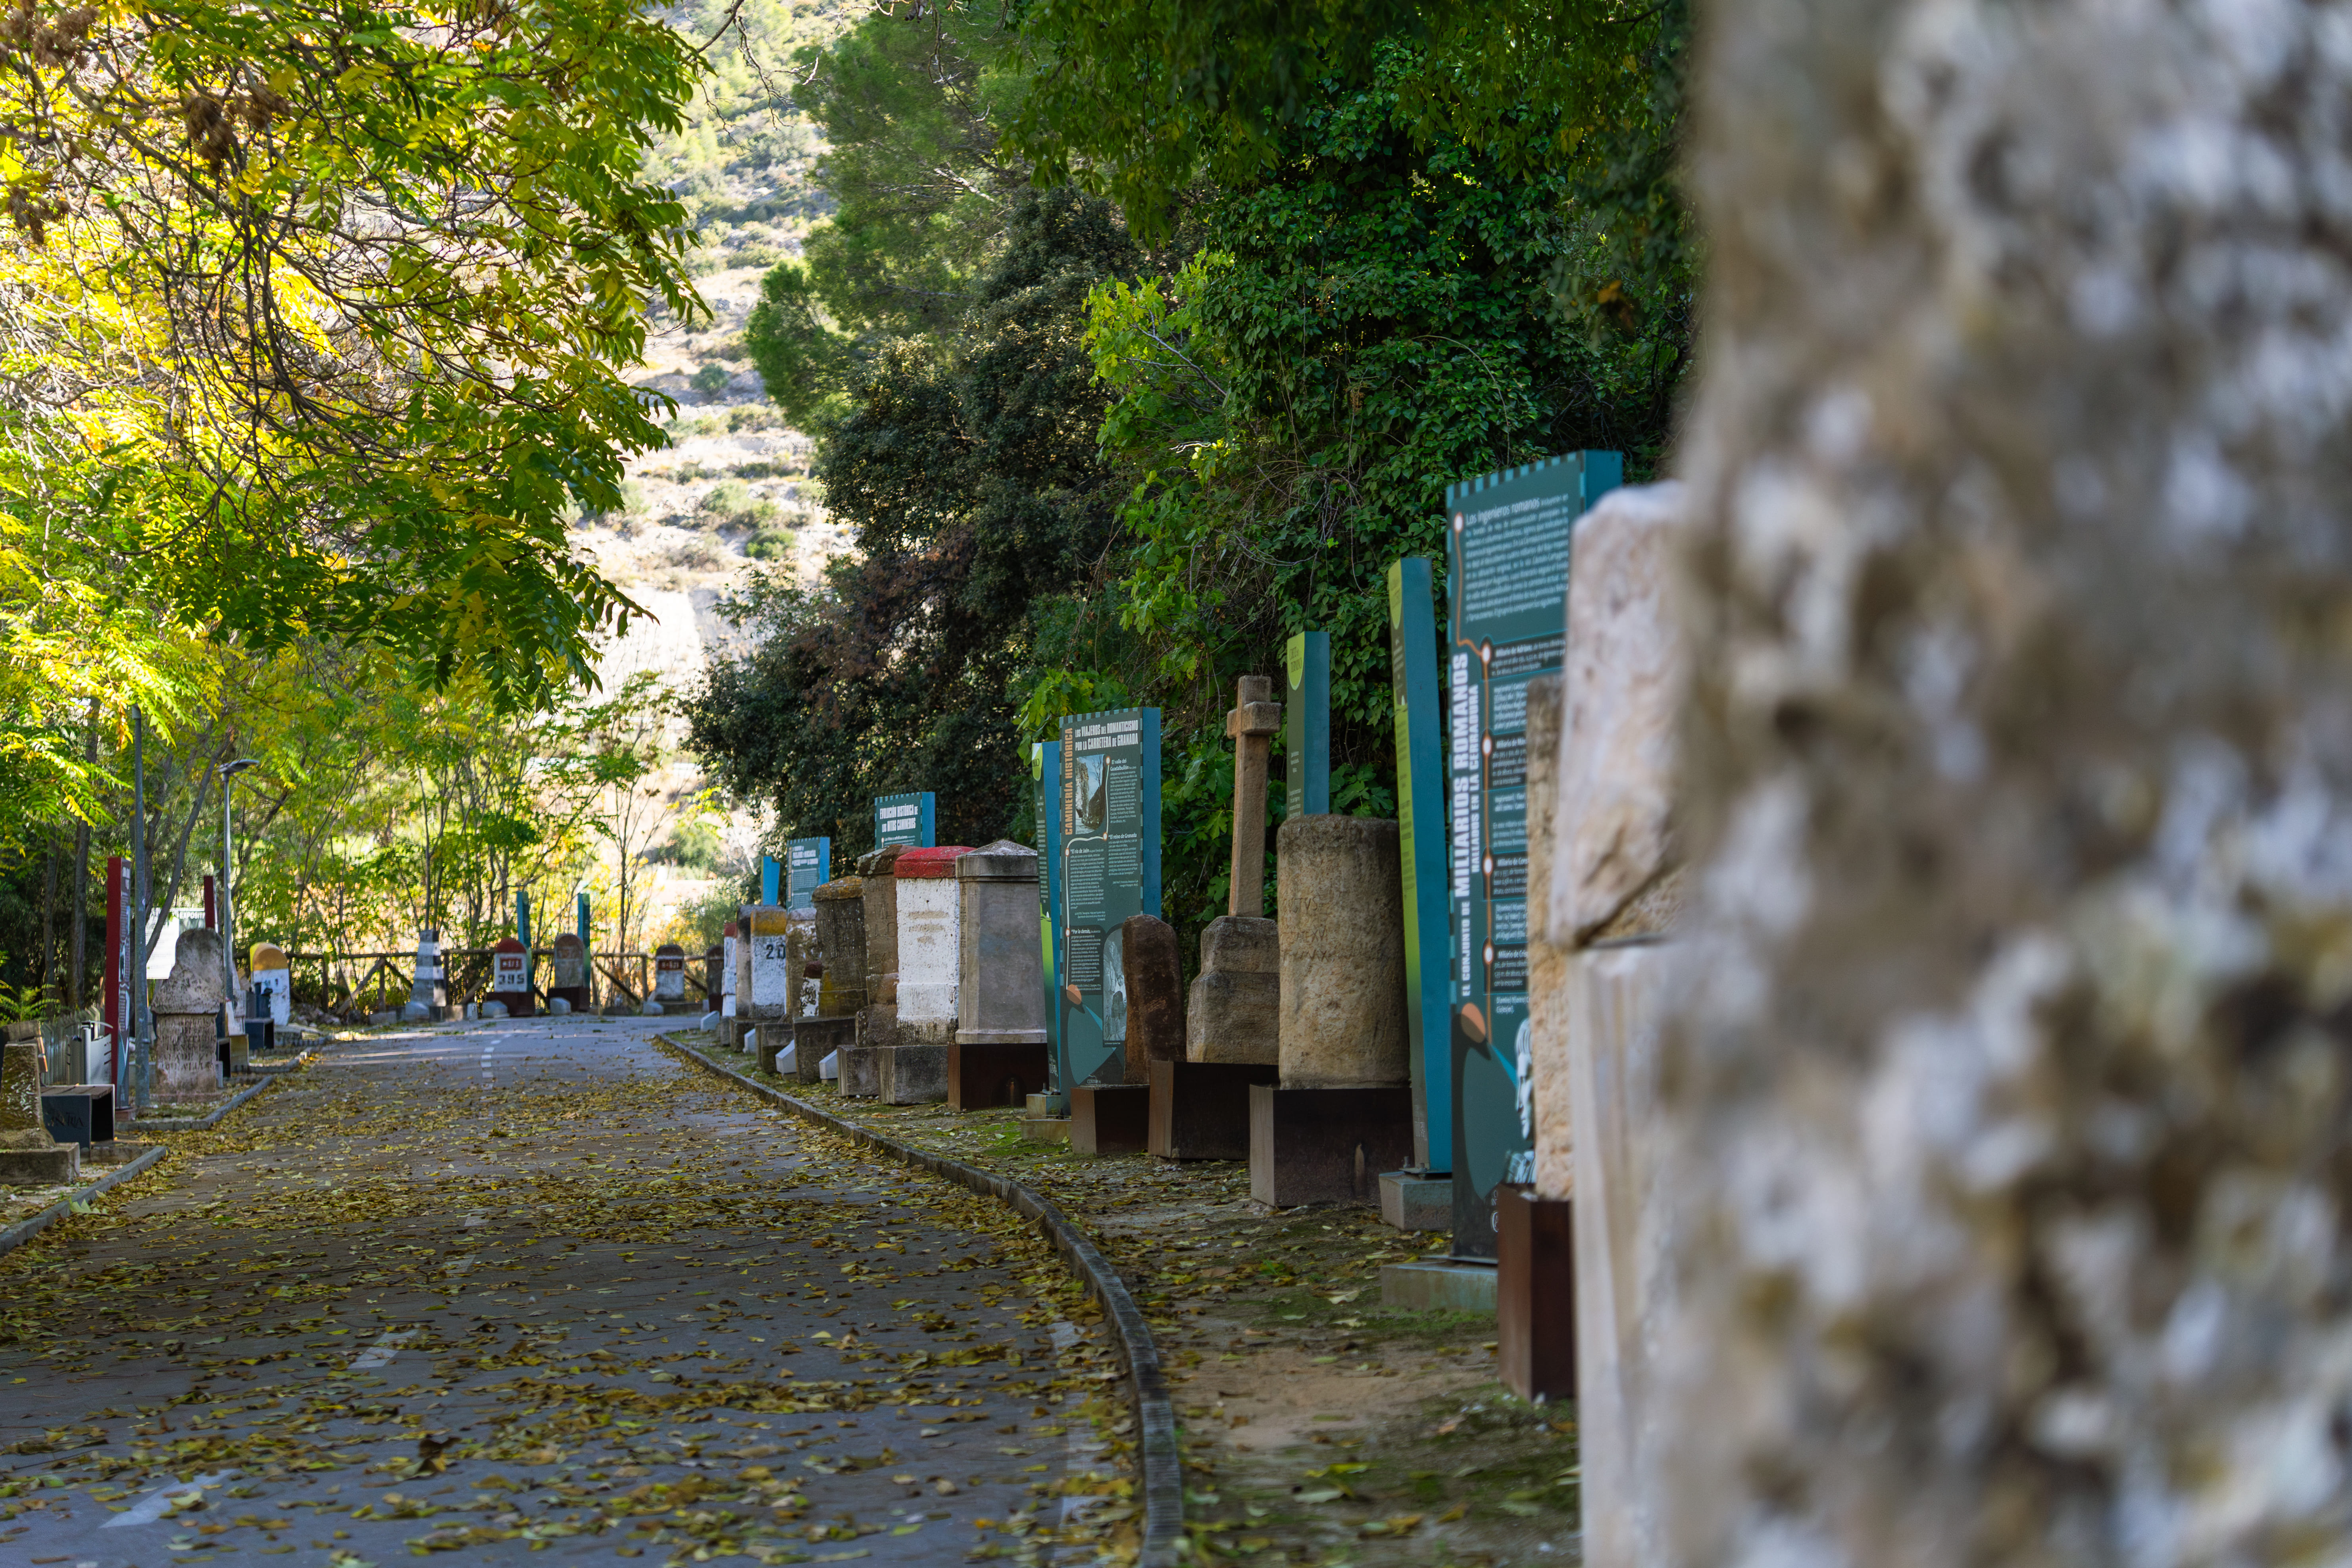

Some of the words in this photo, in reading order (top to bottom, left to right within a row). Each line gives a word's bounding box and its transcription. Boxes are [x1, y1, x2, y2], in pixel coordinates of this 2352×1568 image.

[1466, 513, 1477, 526] Los
[1511, 498, 1540, 513] romanos
[1452, 653, 1469, 770] ROMANOS
[1081, 724, 1100, 737] VIAJEROS
[1107, 720, 1138, 733] ROMANTICISMO
[1469, 685, 1479, 770] CERRADURA
[1083, 741, 1087, 750] LA
[1088, 736, 1111, 750] CARRETERA
[1112, 737, 1117, 747] DE
[1117, 733, 1138, 746] GRANADA
[1063, 727, 1073, 779] HISTÓRICA
[1470, 774, 1479, 791] LA
[880, 805, 897, 820] EVOLUCIÓN
[897, 804, 914, 818] HISTÓRICA
[914, 806, 918, 815] DE
[1064, 781, 1073, 835] CAMINERÍA
[1471, 795, 1479, 810] EN
[887, 820, 896, 832] HITOS
[897, 817, 916, 831] CAMINEROS
[1453, 776, 1469, 897] MILIARIOS
[1471, 813, 1479, 873] HALLADOS
[1461, 901, 1470, 915] DE
[1462, 919, 1470, 981] CONJUNTO
[1462, 984, 1470, 996] EL
